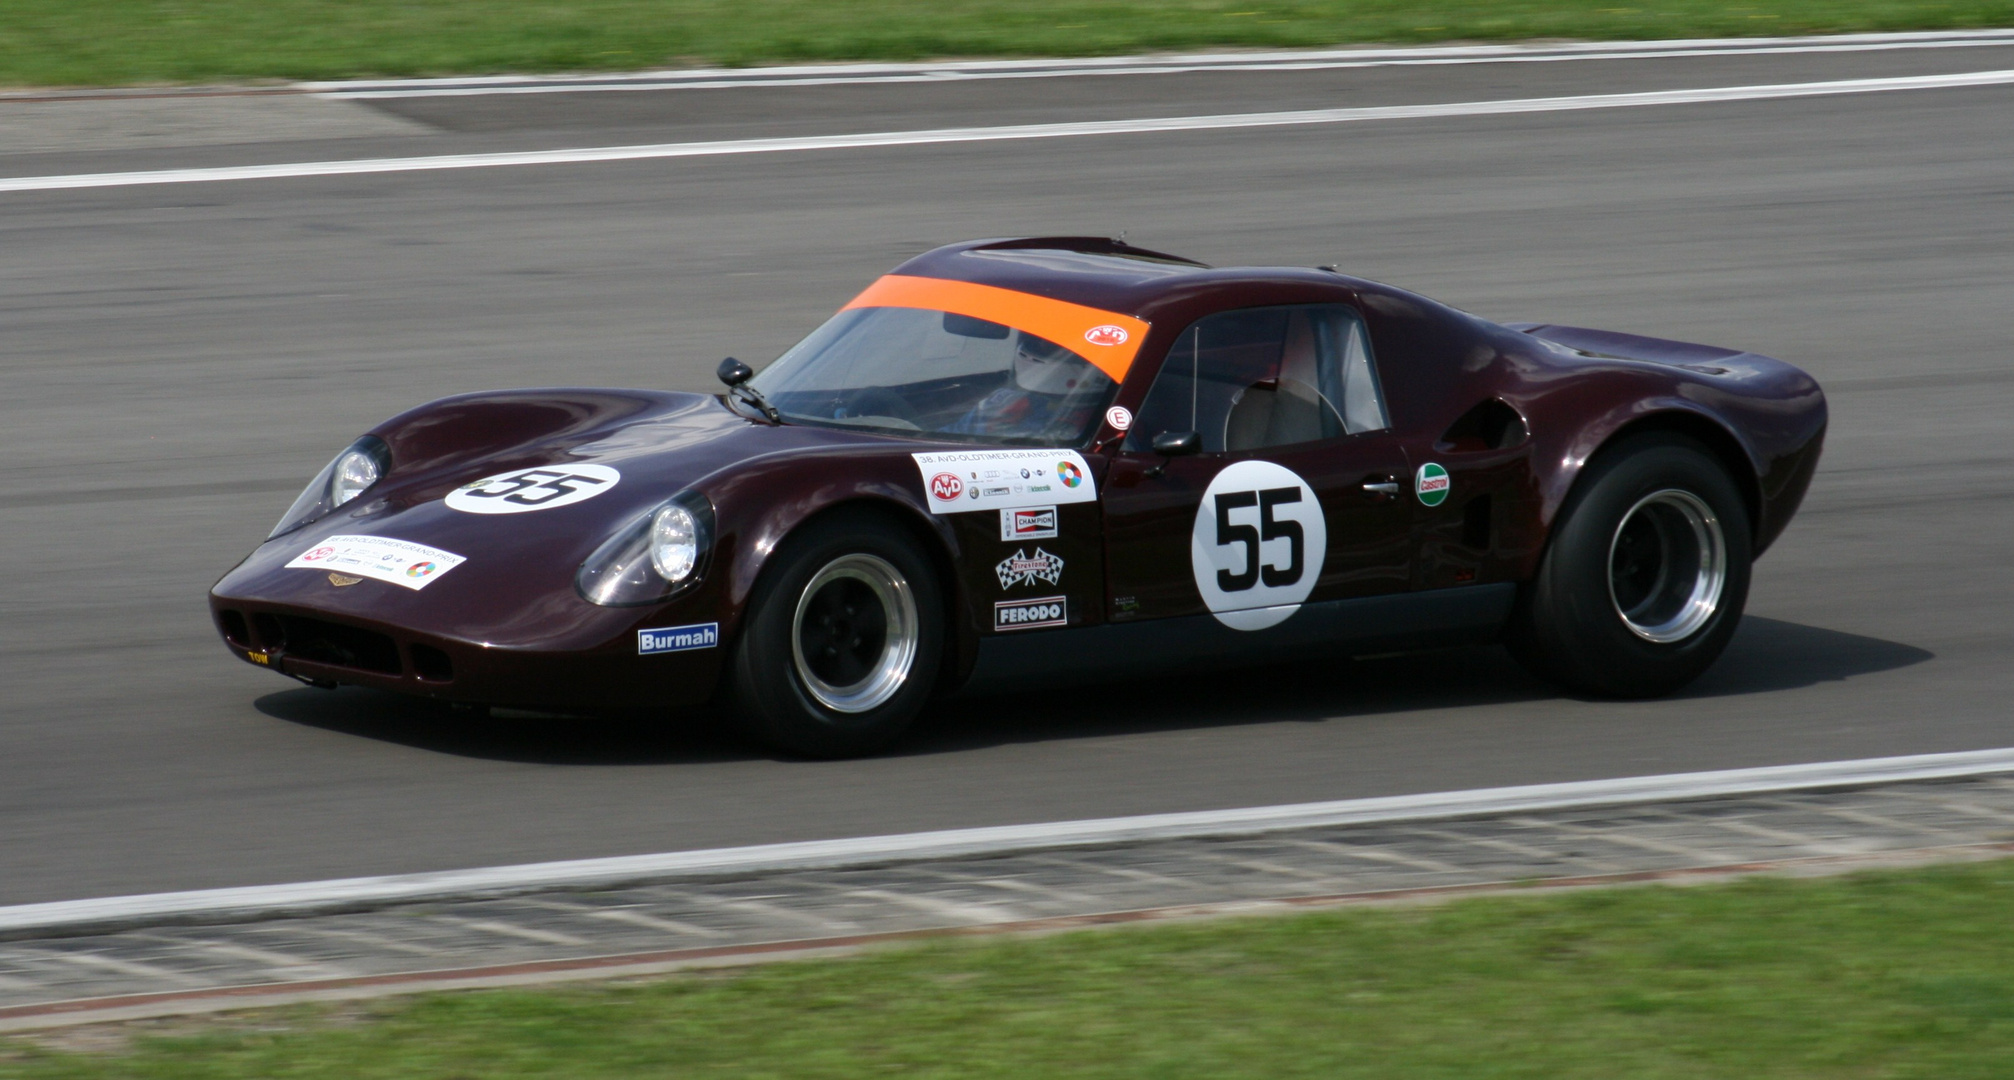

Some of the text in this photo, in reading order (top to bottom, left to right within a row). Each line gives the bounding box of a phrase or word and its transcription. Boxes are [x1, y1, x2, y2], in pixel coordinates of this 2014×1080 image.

[1113, 411, 1126, 424] E
[919, 456, 937, 464] 38.
[465, 469, 608, 506] 55
[1420, 477, 1448, 491] Castrol
[1018, 516, 1053, 526] CHAMPION
[1214, 485, 1304, 593] 55
[1013, 561, 1048, 570] Firestone
[1000, 603, 1061, 624] FERODO
[641, 628, 715, 650] Burmah
[248, 651, 268, 665] TOW
